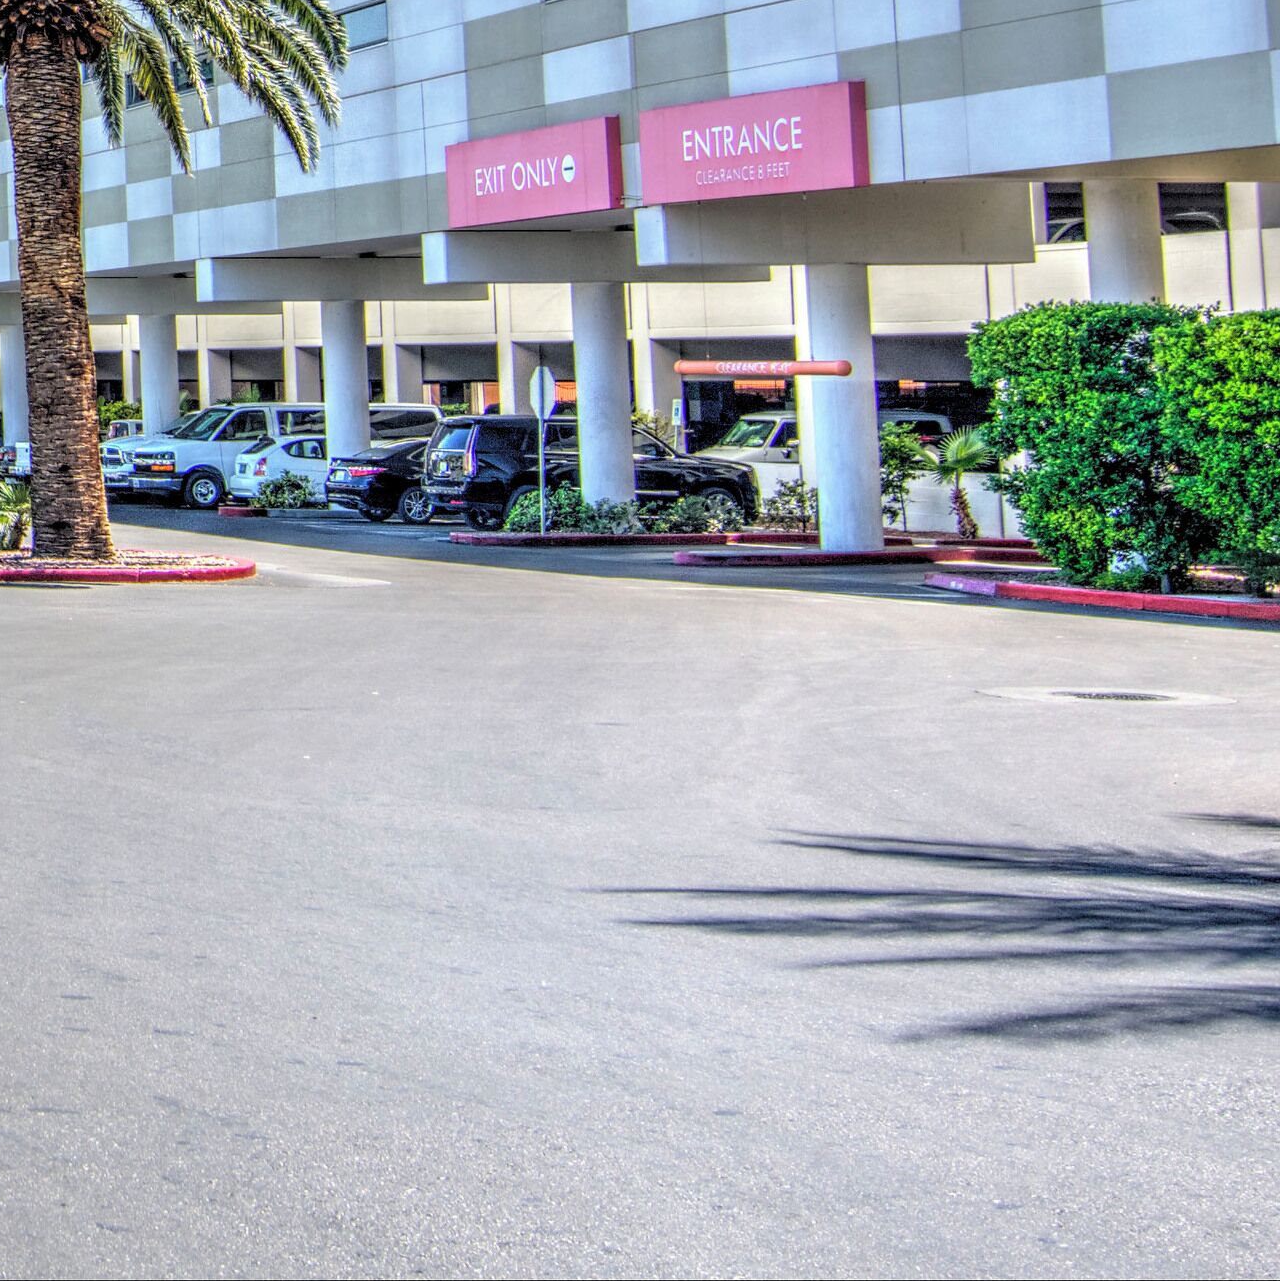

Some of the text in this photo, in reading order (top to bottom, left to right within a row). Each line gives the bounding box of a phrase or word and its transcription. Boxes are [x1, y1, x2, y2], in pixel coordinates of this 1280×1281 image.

[683, 116, 803, 161] ENTRANCE
[475, 156, 558, 196] EXIT ONLY
[695, 165, 755, 186] CLEARANCE
[767, 161, 791, 178] FEET
[715, 361, 768, 374] CLEARANCE
